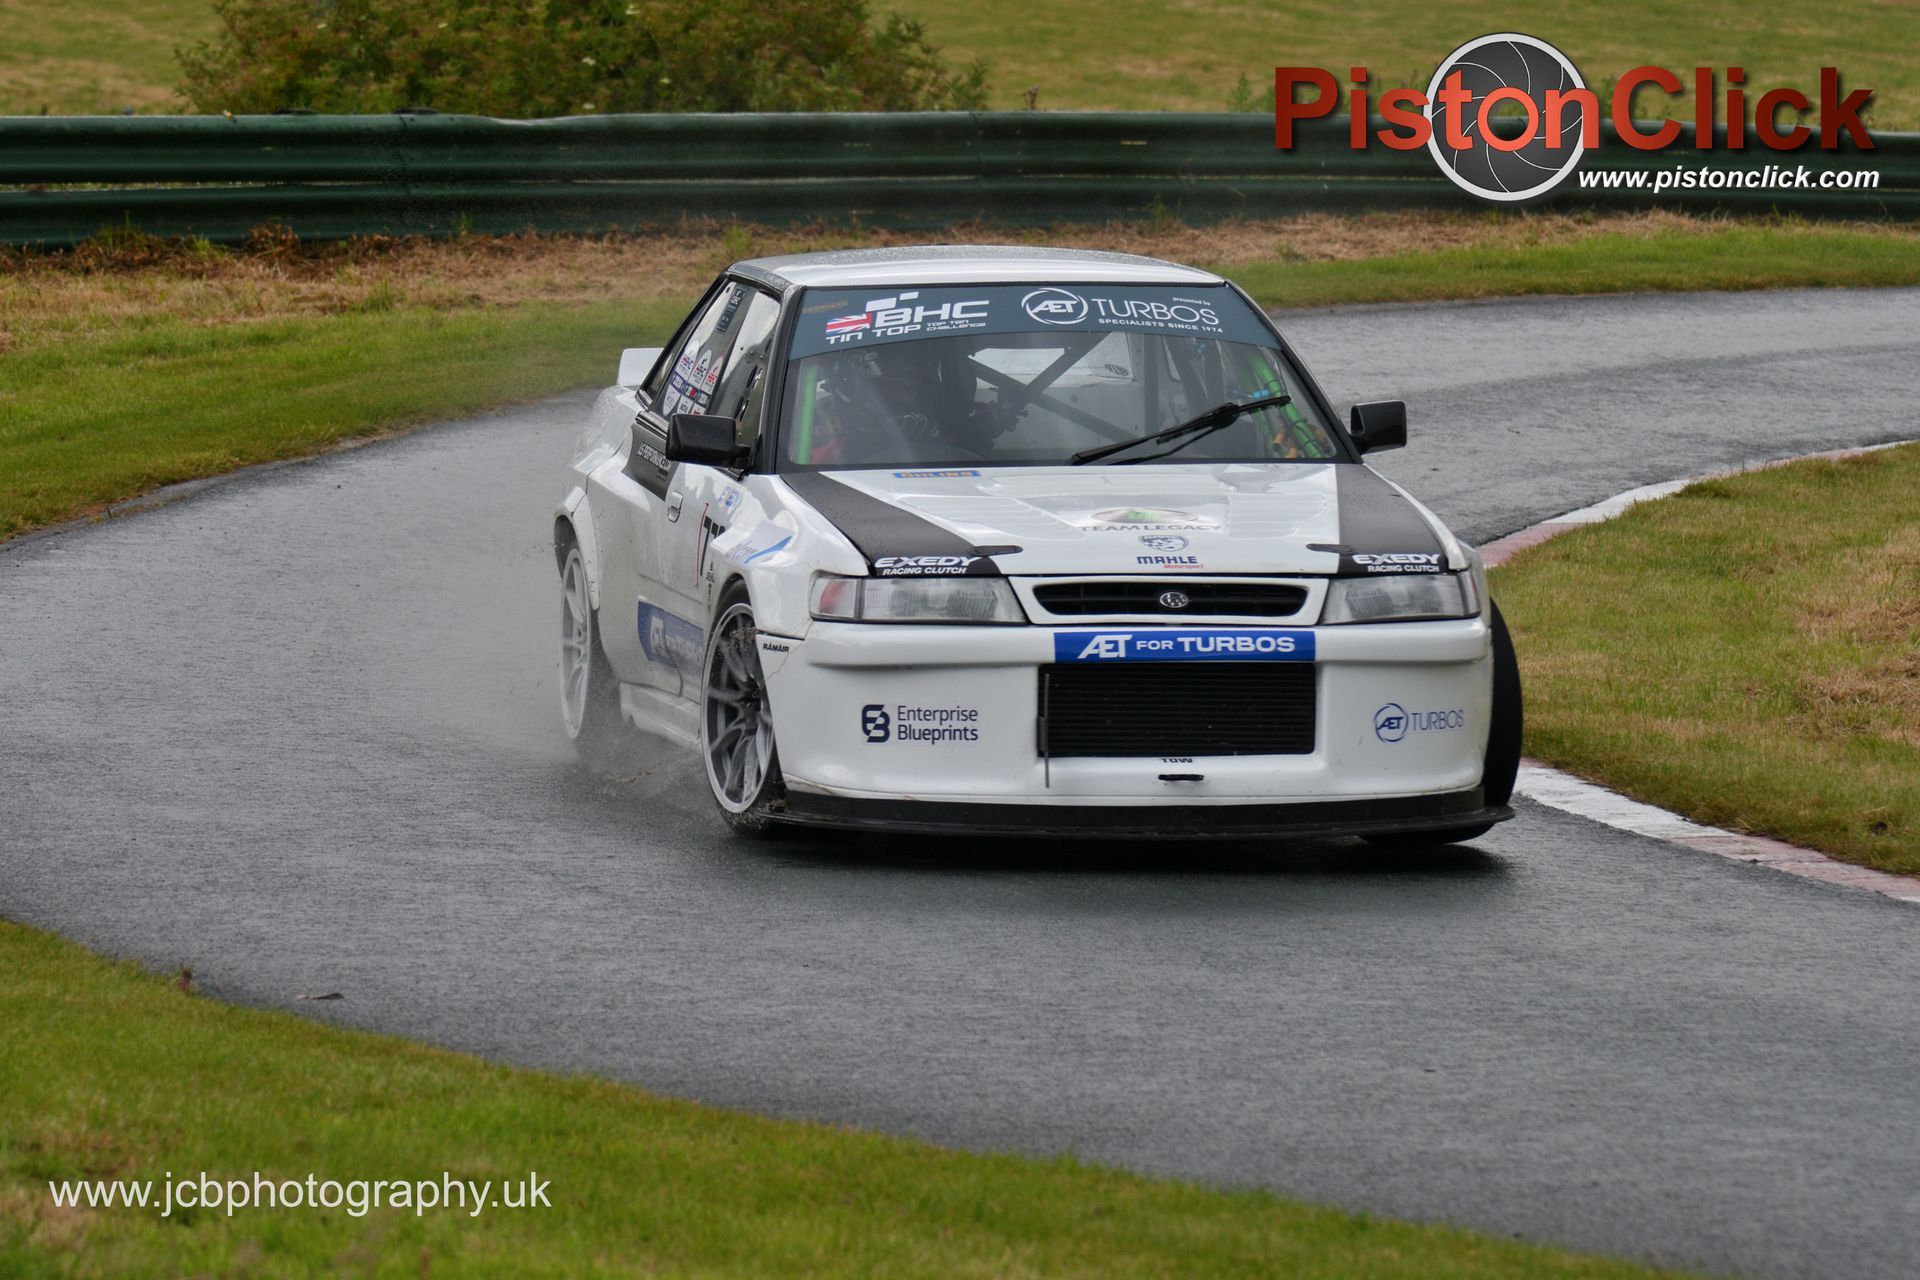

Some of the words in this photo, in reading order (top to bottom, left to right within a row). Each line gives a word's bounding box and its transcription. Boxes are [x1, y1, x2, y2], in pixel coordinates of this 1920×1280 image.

[875, 300, 990, 328] BHC
[1091, 298, 1220, 326] TURBOS
[1098, 318, 1165, 328] SPECIALISTS
[1167, 323, 1199, 331] SINCE
[826, 332, 863, 345] TIN
[872, 324, 921, 338] TOP
[1082, 524, 1140, 532] TEAM
[874, 556, 983, 568] EXEDY
[1136, 556, 1198, 565] MAHLE
[1352, 553, 1441, 565] EXEDY
[882, 567, 922, 576] RACING
[924, 566, 967, 575] CLUTCH
[1367, 565, 1403, 573] RACING
[1403, 564, 1440, 573] CLUTCH
[1136, 640, 1174, 650] FOR
[1176, 636, 1296, 653] TURBOS
[897, 705, 978, 725] Enterprise
[1411, 709, 1464, 731] TURBOS
[897, 724, 979, 745] Blueprints
